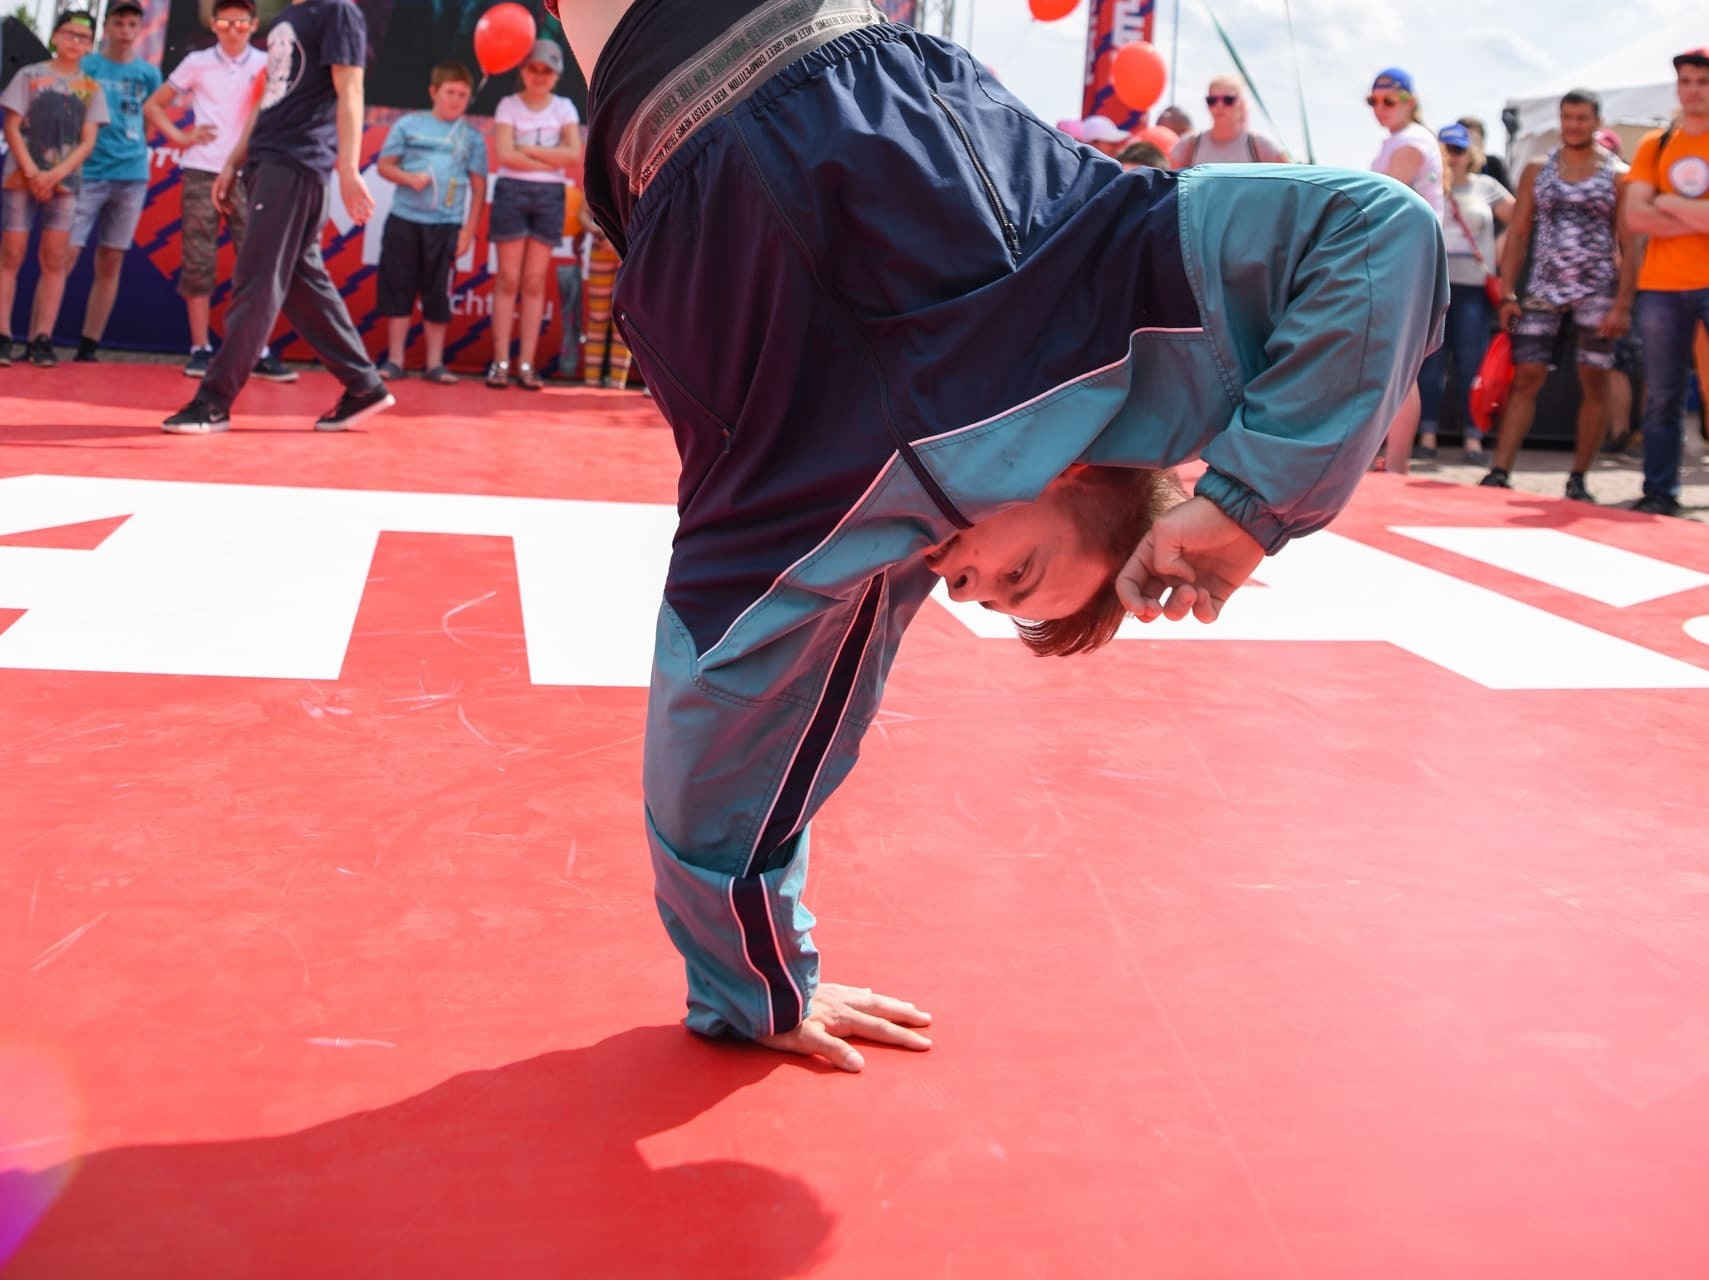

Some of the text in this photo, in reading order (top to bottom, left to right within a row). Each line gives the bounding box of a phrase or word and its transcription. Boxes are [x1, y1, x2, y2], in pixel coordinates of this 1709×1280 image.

[782, 32, 798, 46] AND
[796, 25, 815, 39] MEET
[764, 39, 785, 60] GREET
[691, 68, 711, 86] ON
[726, 54, 768, 92] COMPETITION
[673, 79, 698, 102] THE
[710, 87, 729, 105] VERY
[690, 99, 714, 122] LATEST
[674, 116, 693, 138] NEWS
[662, 132, 679, 153] FROM
